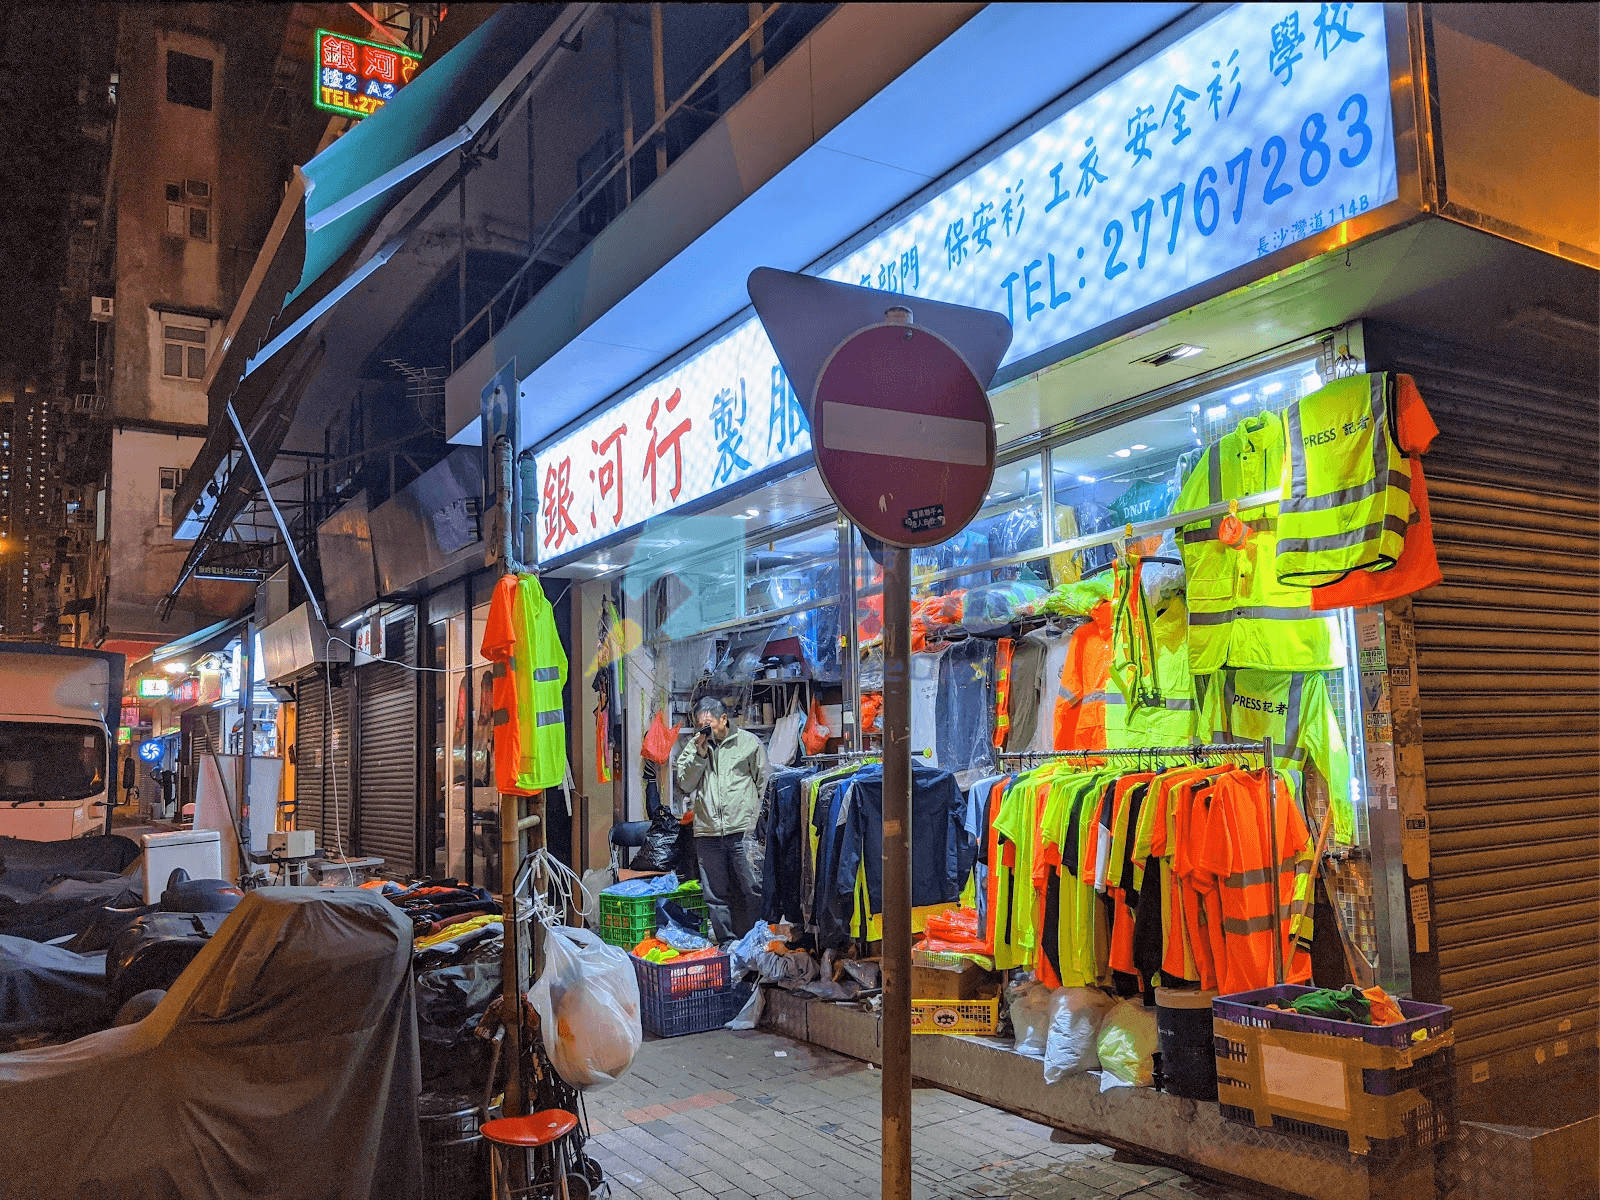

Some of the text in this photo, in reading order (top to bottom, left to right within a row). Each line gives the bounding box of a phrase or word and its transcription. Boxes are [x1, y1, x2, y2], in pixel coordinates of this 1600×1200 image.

[323, 36, 397, 81] 銀河
[321, 86, 385, 114] TEL:27
[860, 244, 920, 295] 部門
[943, 179, 1026, 271] 保安衫
[1044, 136, 1109, 214] 工衣
[1124, 48, 1242, 169] 安全衫
[1304, 415, 1370, 449] PRESS 記者
[542, 387, 692, 550] 銀河行
